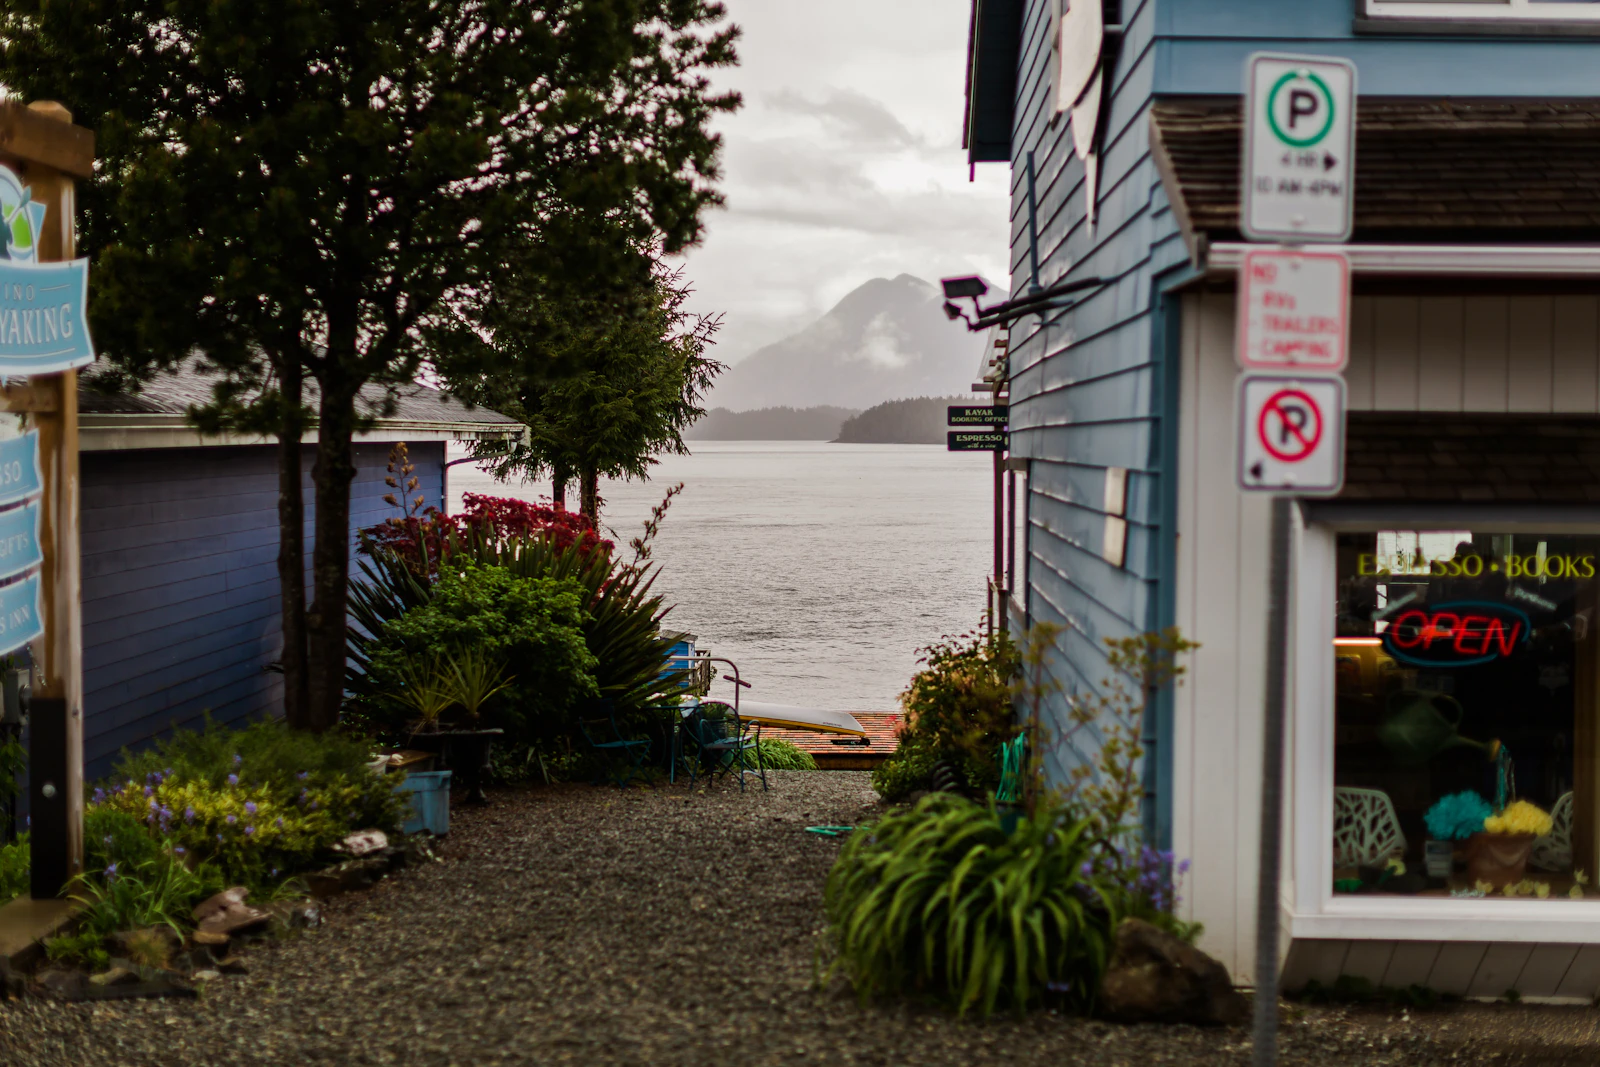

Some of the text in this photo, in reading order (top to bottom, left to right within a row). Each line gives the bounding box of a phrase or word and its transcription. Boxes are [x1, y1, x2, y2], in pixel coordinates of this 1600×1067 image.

[1288, 88, 1319, 130] P
[1252, 264, 1278, 284] NO
[1262, 313, 1340, 335] TRAILERS
[1261, 338, 1332, 358] CAMPING
[956, 434, 1003, 442] ESPRESSO
[0, 460, 22, 486] SO
[1505, 554, 1596, 578] BOOKS
[9, 603, 30, 630] INN
[1391, 609, 1522, 658] OPEN
